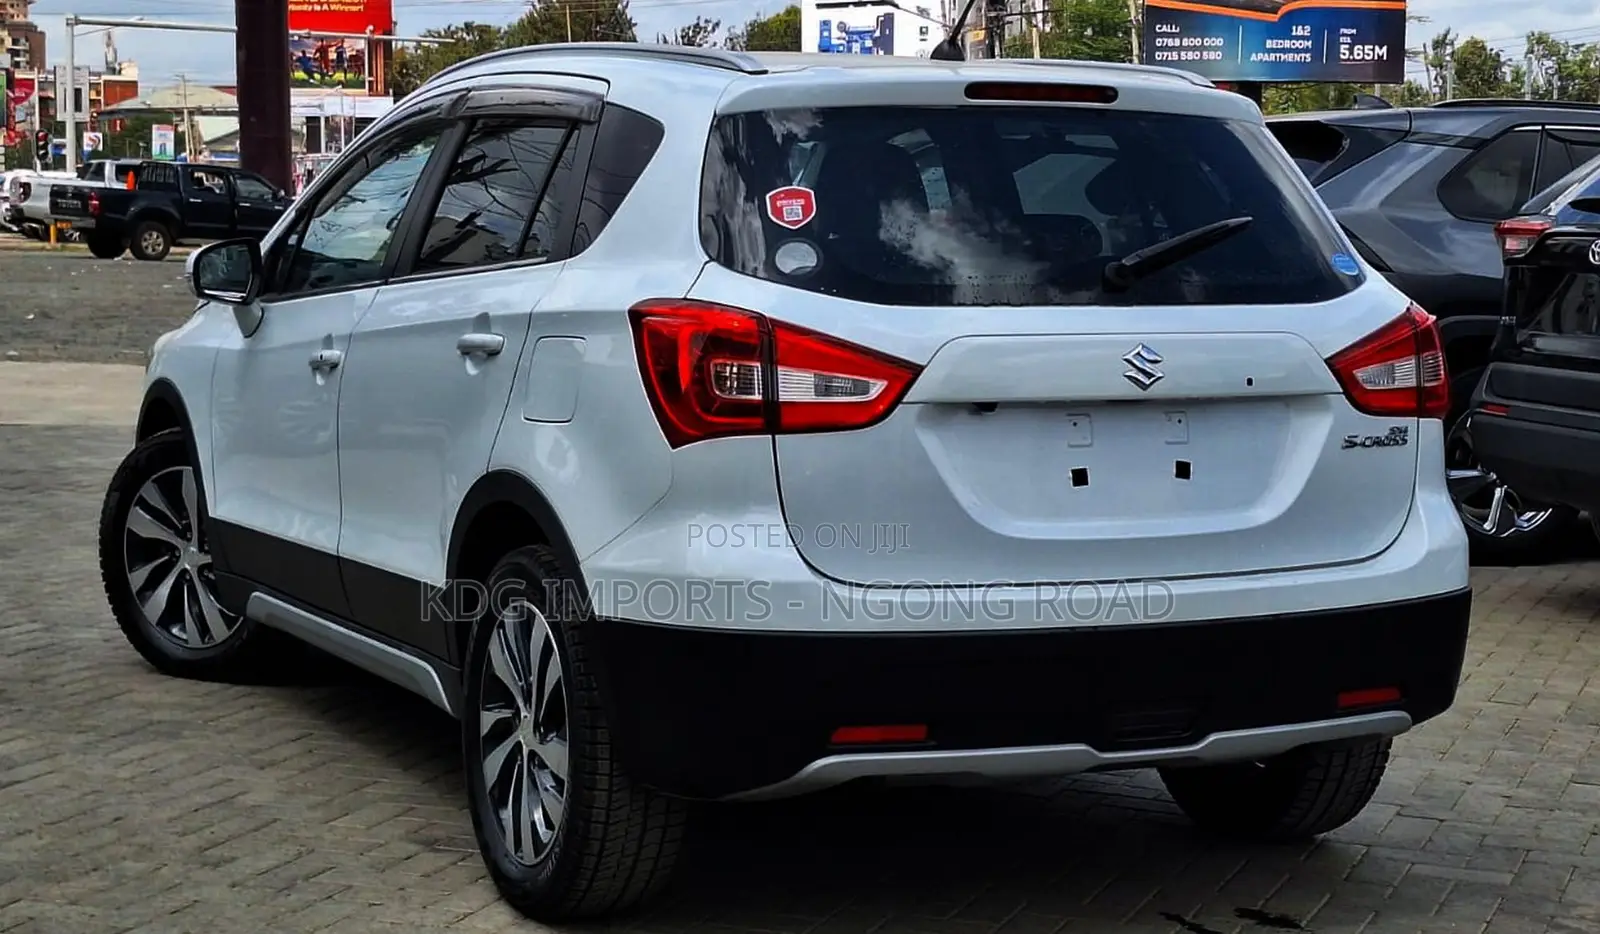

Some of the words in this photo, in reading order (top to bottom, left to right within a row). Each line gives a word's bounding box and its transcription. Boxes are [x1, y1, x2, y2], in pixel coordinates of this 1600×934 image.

[1291, 25, 1311, 36] 1&2
[1203, 37, 1224, 46] 000
[1265, 39, 1312, 49] BEDROOM
[1250, 52, 1312, 62] APARTMENTS
[1339, 44, 1388, 61] 5.65M
